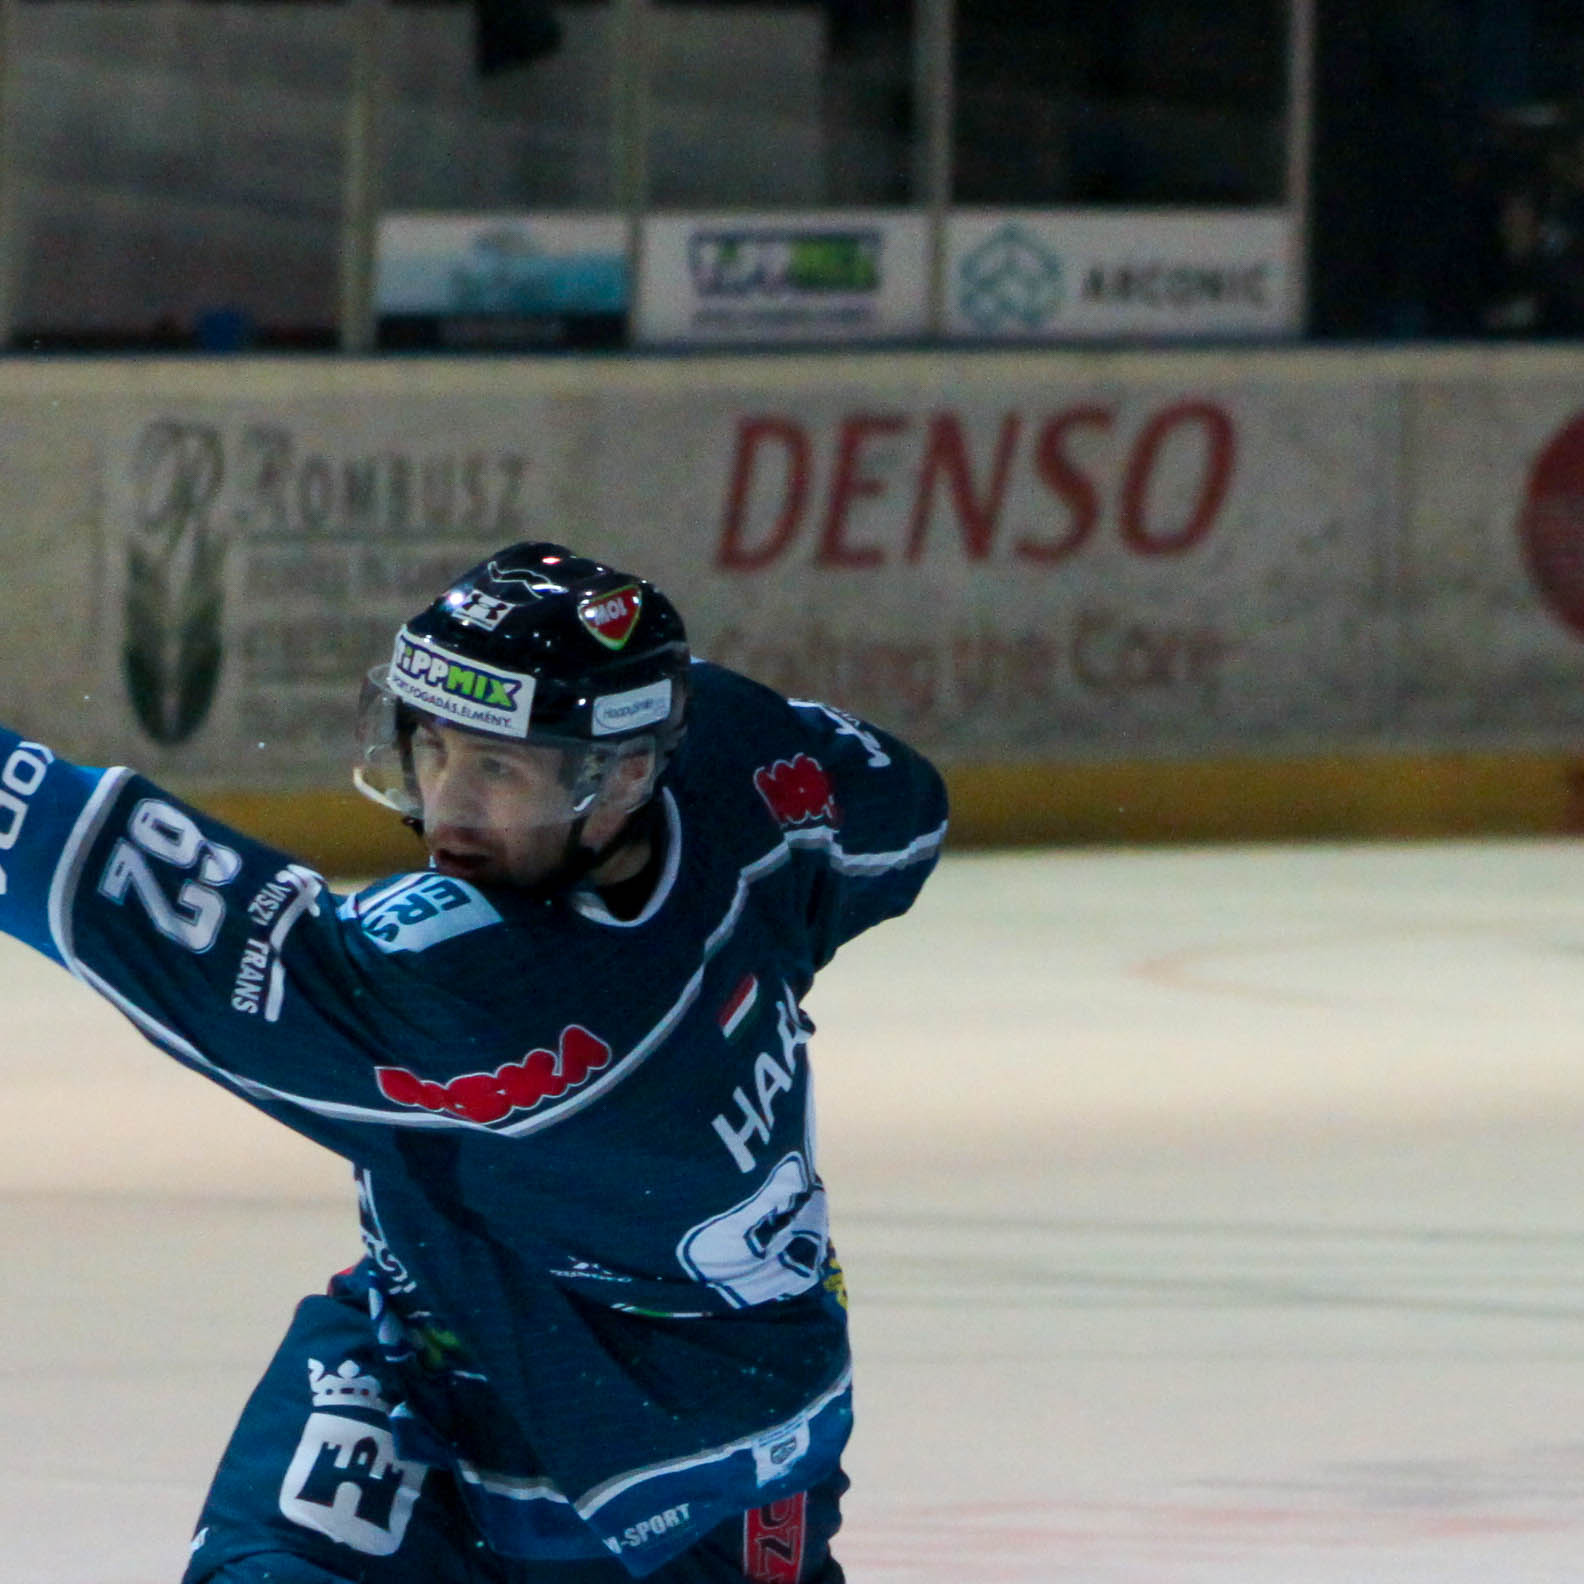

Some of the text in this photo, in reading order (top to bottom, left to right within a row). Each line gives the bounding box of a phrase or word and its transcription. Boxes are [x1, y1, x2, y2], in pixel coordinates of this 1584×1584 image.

[713, 395, 1239, 571] DENSO
[97, 797, 243, 954] 62
[231, 937, 270, 1014] TRANS
